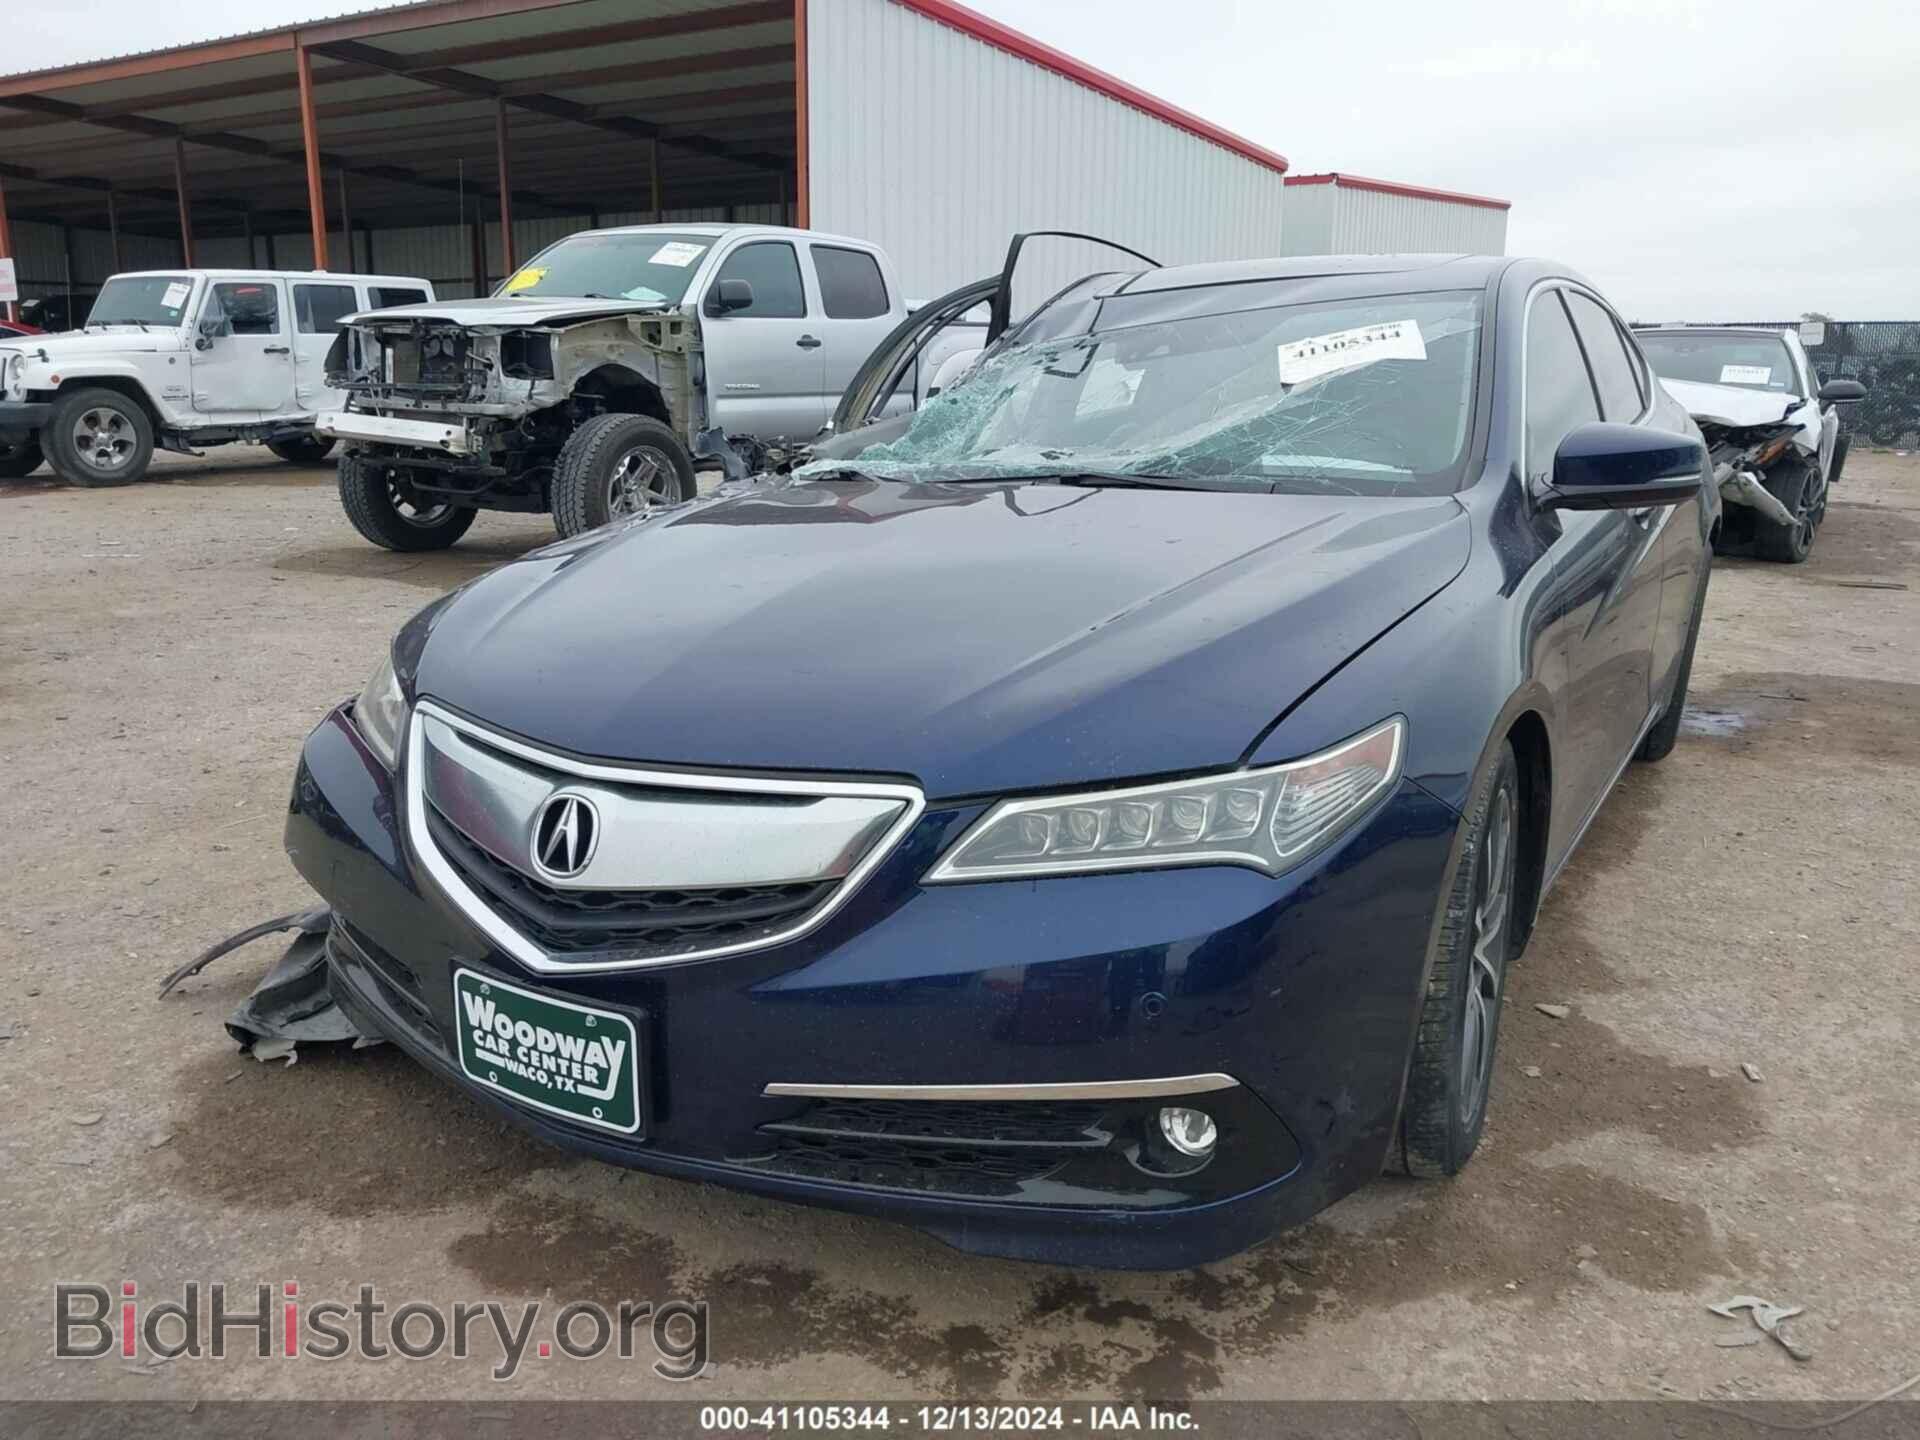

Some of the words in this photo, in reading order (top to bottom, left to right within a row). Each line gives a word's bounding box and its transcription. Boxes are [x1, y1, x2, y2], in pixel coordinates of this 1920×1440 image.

[462, 990, 626, 1076] WOODWAY
[472, 1029, 512, 1057] CAR
[516, 1046, 599, 1084] CENTER
[504, 1058, 552, 1089] WACO,
